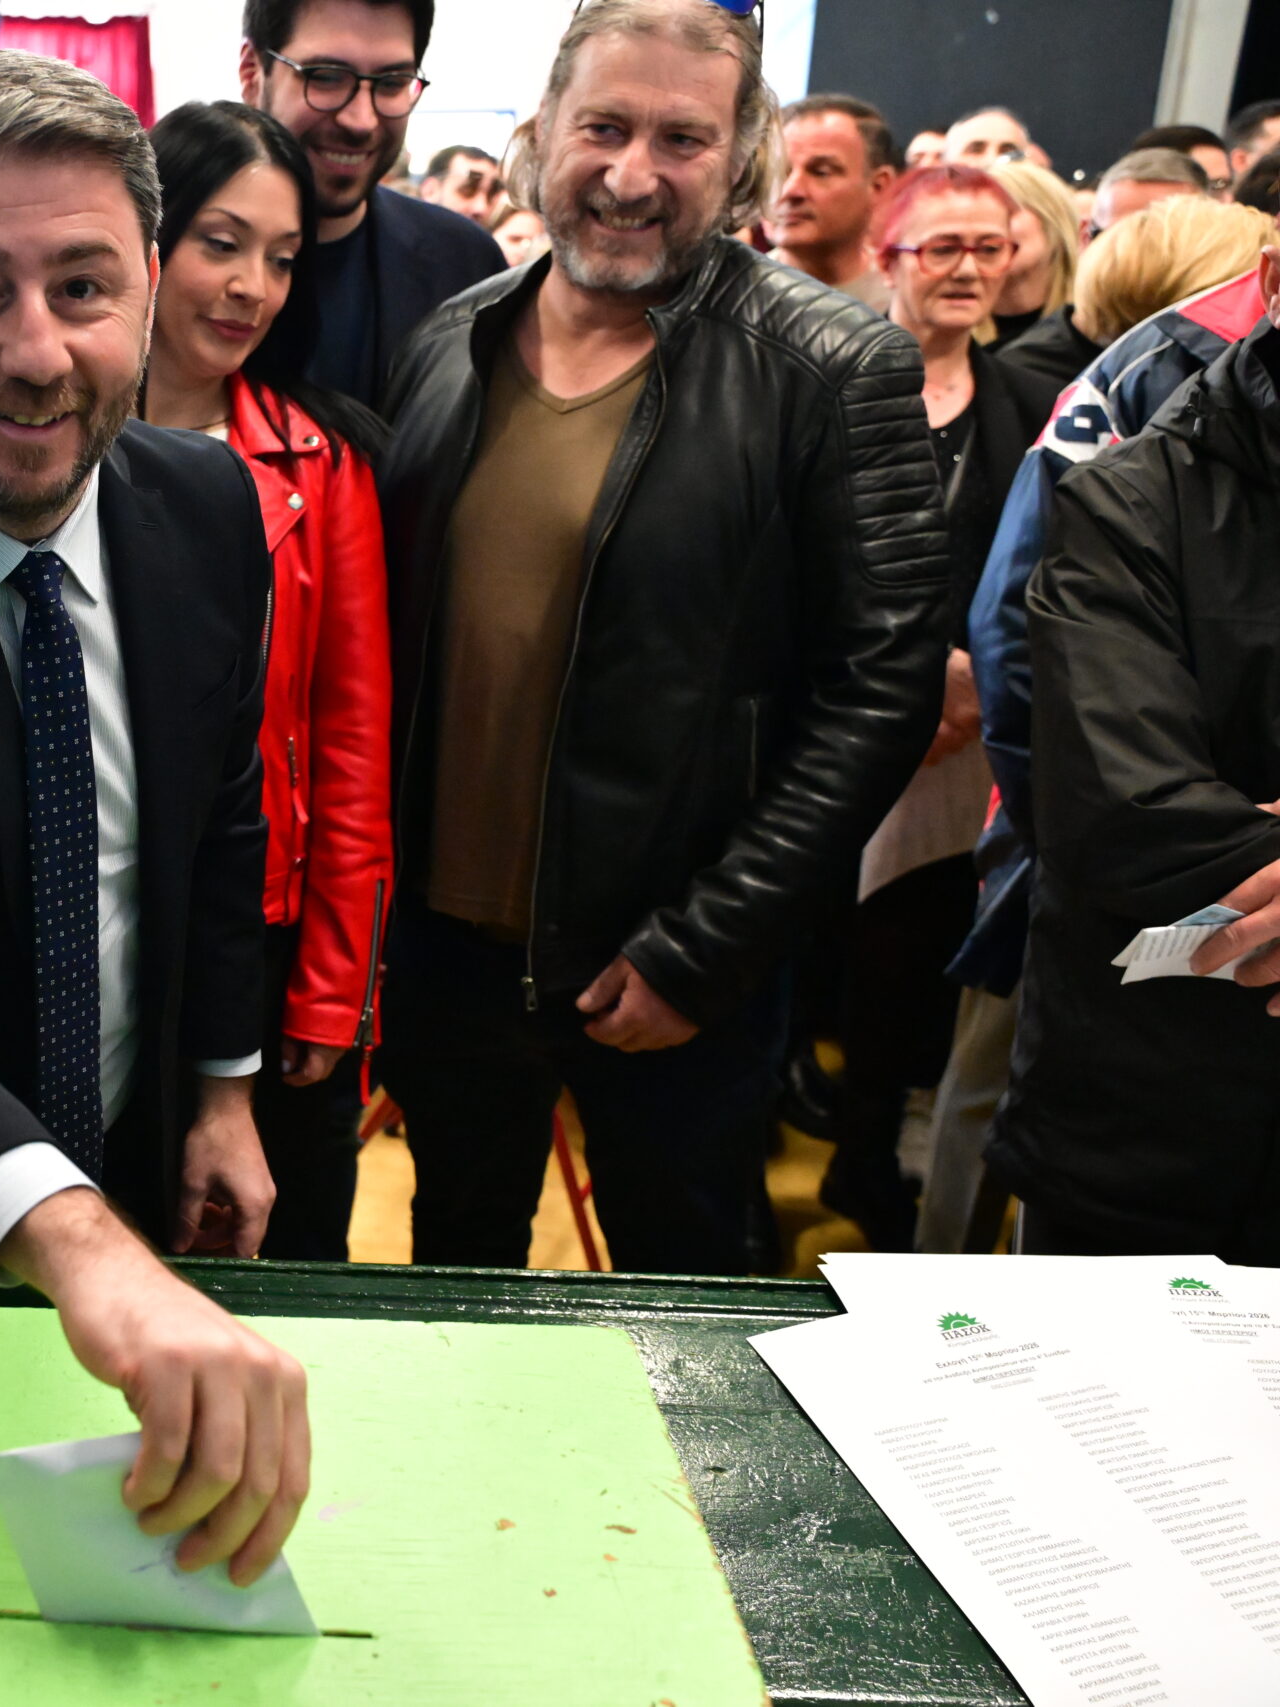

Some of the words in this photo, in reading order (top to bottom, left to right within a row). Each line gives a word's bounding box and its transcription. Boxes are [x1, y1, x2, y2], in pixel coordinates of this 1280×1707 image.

[1168, 1289, 1223, 1297] ΠΑΣΟΚ
[941, 1324, 991, 1340] ΠΑΣΟΚ
[984, 1347, 1019, 1359] Μαρτίου
[1019, 1342, 1040, 1352] 2026
